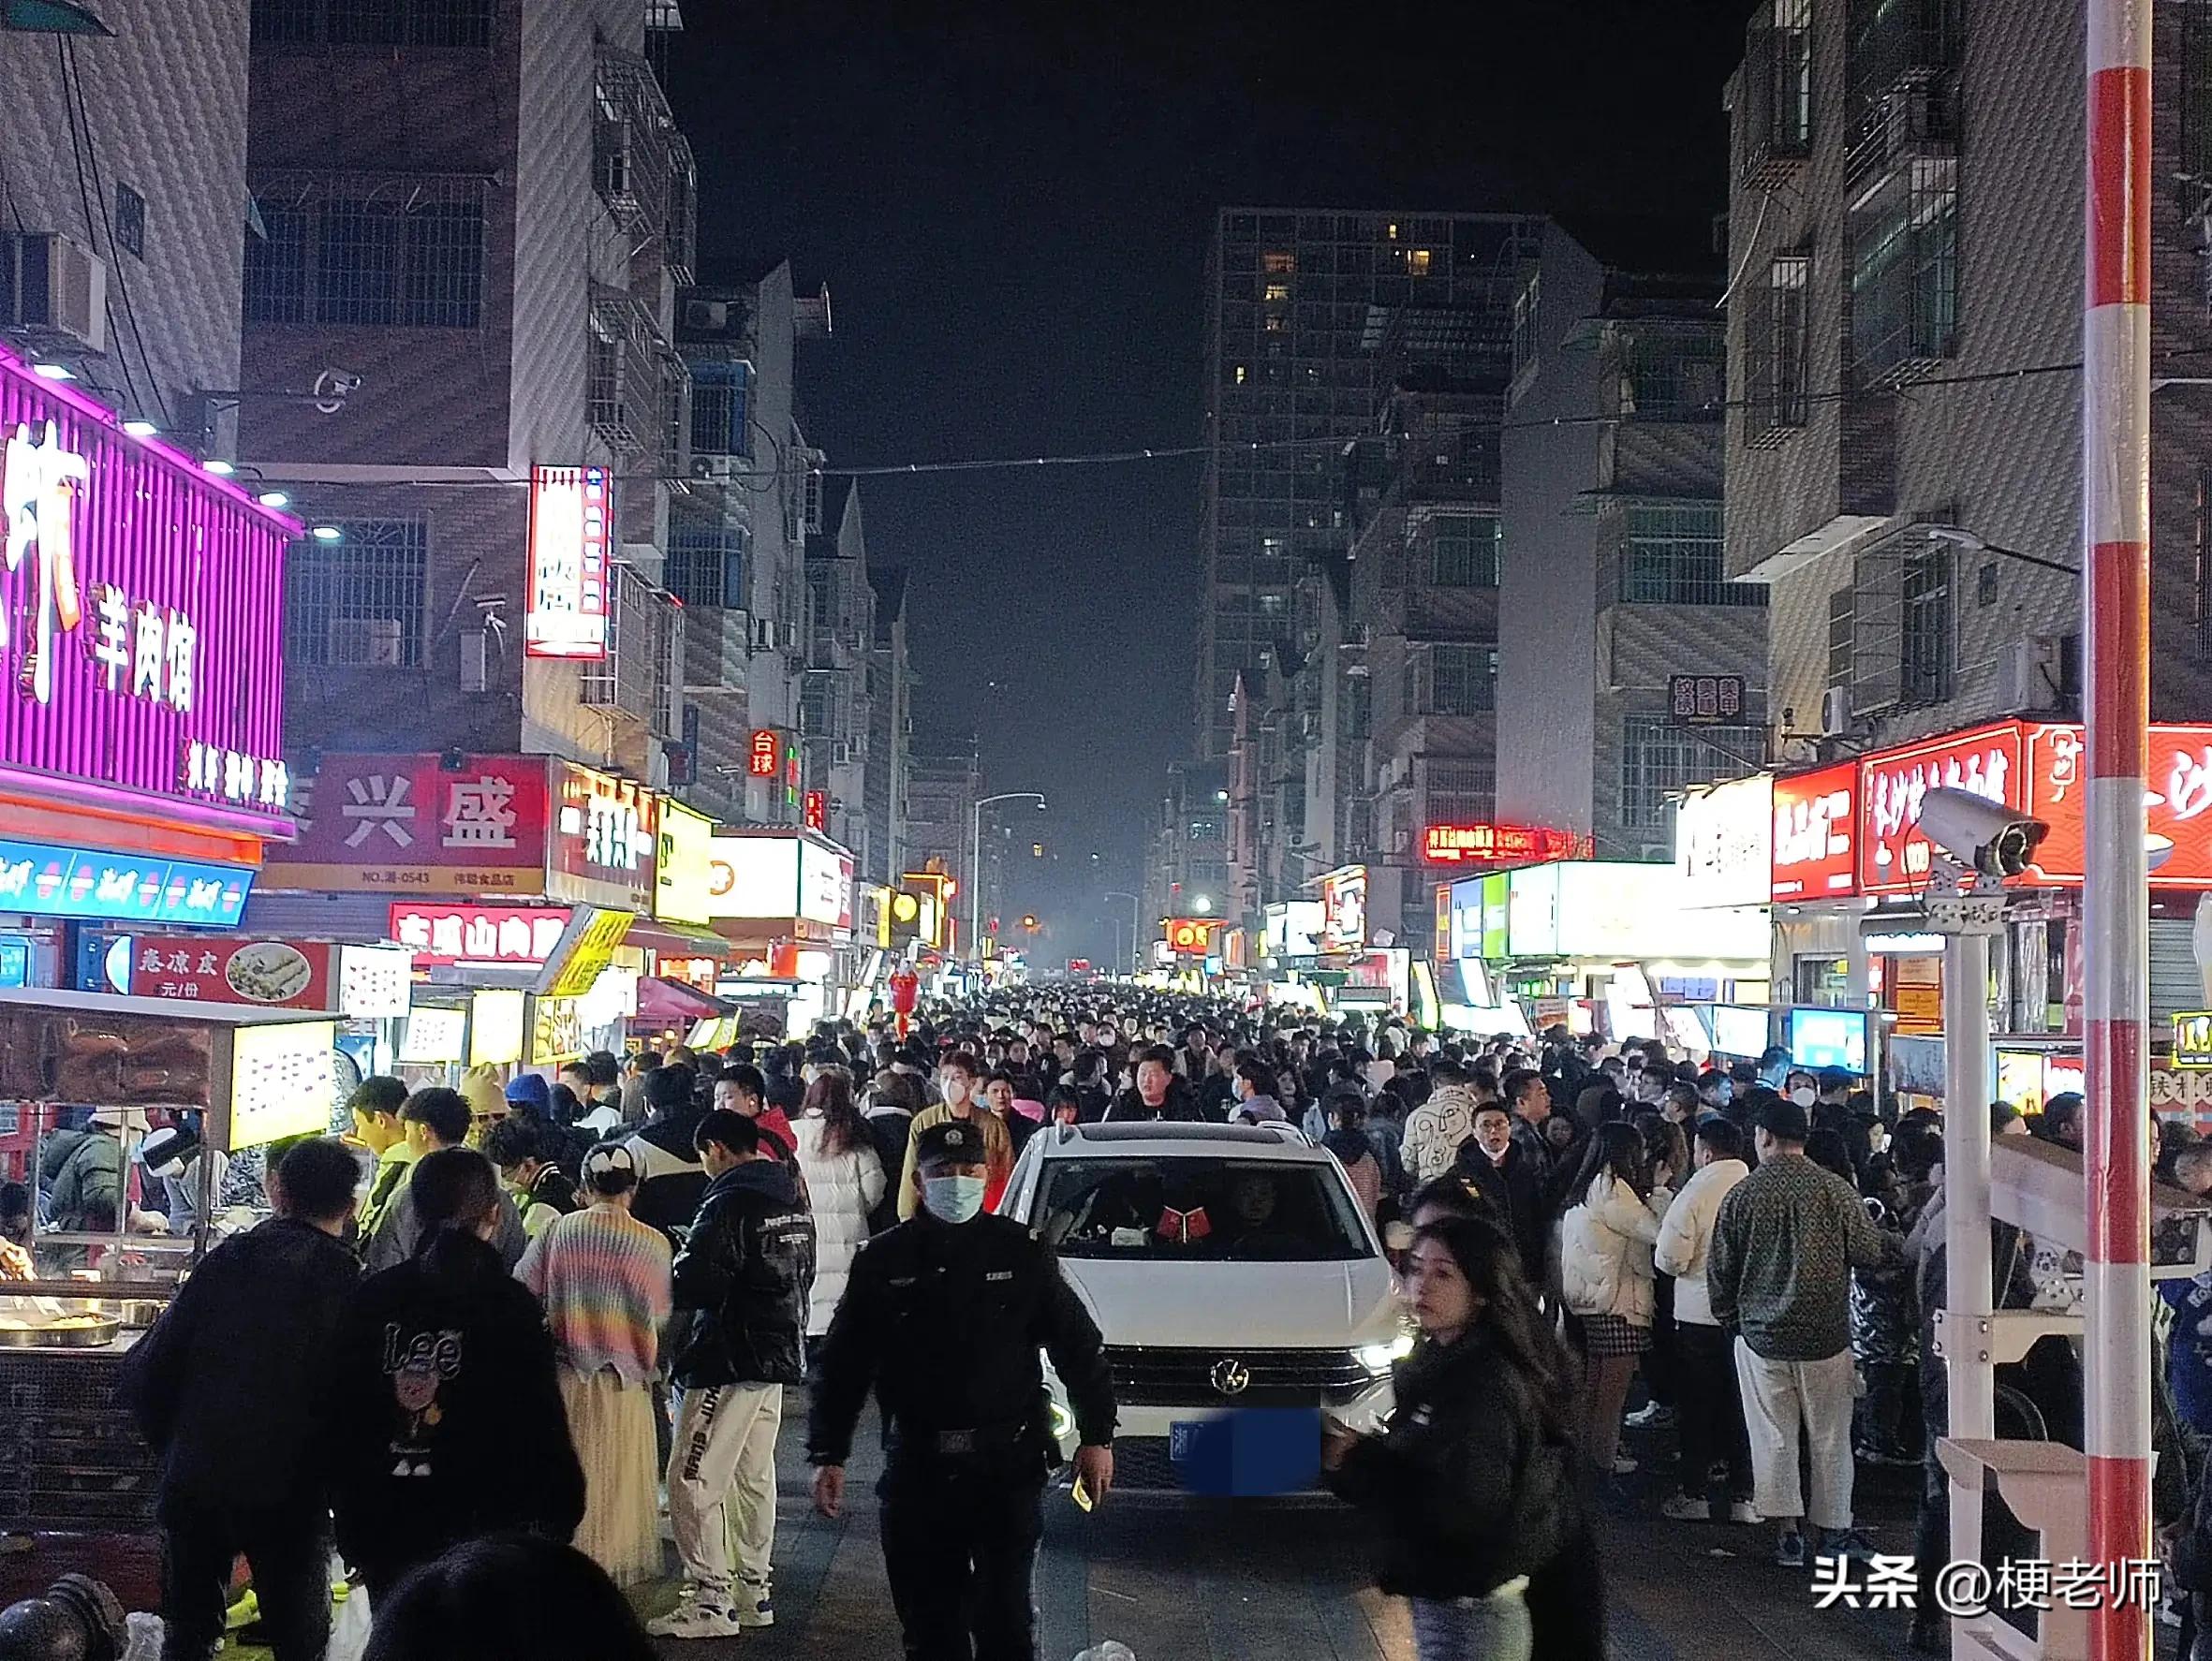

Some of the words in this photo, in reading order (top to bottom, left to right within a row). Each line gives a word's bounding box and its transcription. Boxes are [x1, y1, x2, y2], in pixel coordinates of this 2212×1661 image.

[95, 582, 197, 713] 羊肉馆
[753, 731, 774, 772] 台球
[162, 981, 199, 998] 元/份
[382, 1322, 463, 1381] Lee
